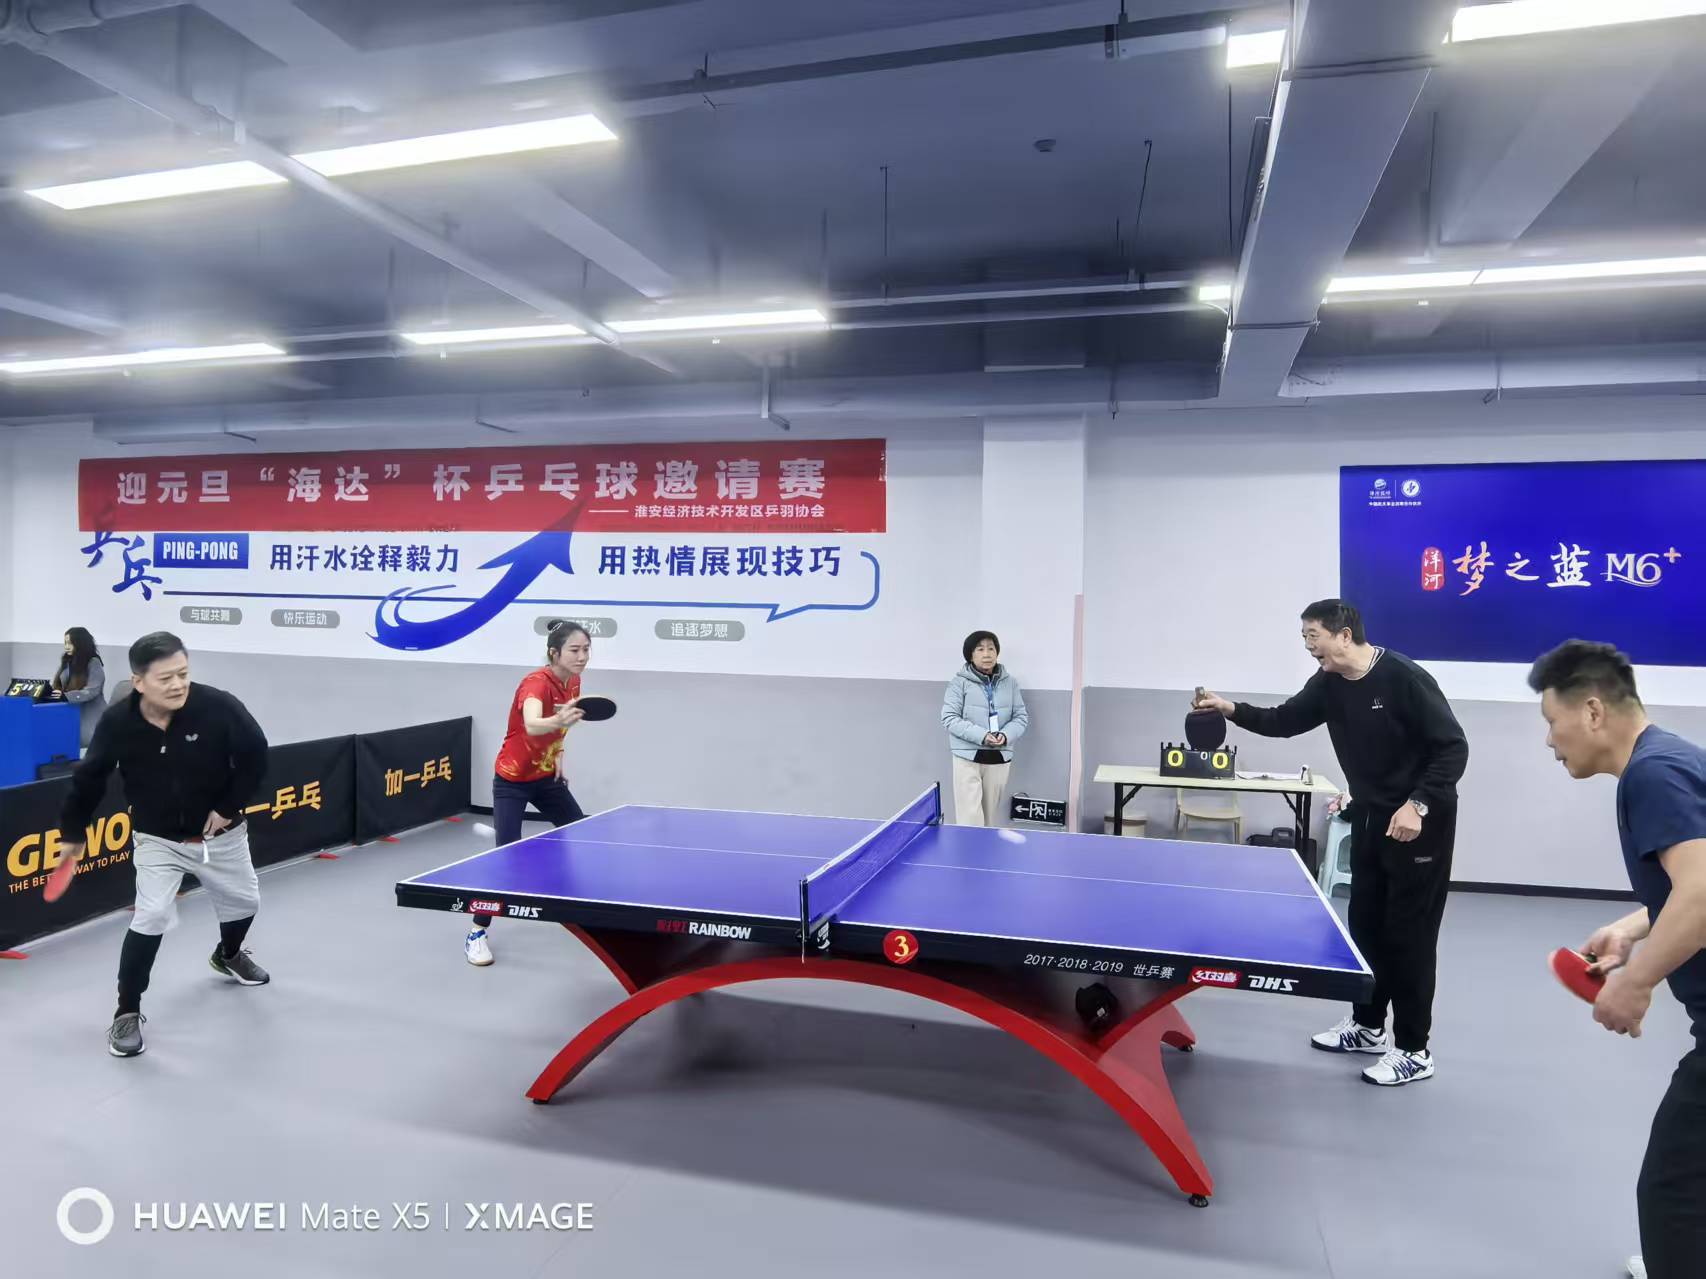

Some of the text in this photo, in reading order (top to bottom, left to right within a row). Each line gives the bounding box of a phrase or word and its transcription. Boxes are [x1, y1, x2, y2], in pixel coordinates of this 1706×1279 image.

[162, 541, 238, 560] PING-PONG
[270, 543, 459, 573] 用汗水诠释毅力
[599, 545, 841, 577] 用热情展现技巧
[1423, 549, 1443, 590] 洋河
[1452, 541, 1592, 597] 梦之蓝
[671, 622, 729, 638] 追逐梦想
[1167, 750, 1184, 767] 0
[1212, 752, 1229, 769] 0
[385, 756, 452, 797] 加一乒乓
[239, 780, 322, 820] 一乒乓
[9, 880, 29, 894] THE
[97, 857, 109, 868] TO
[110, 851, 131, 864] PLAY
[507, 905, 543, 918] DHS
[688, 921, 752, 940] RAINBOW
[894, 935, 910, 957] 3
[1248, 975, 1300, 991] DHS
